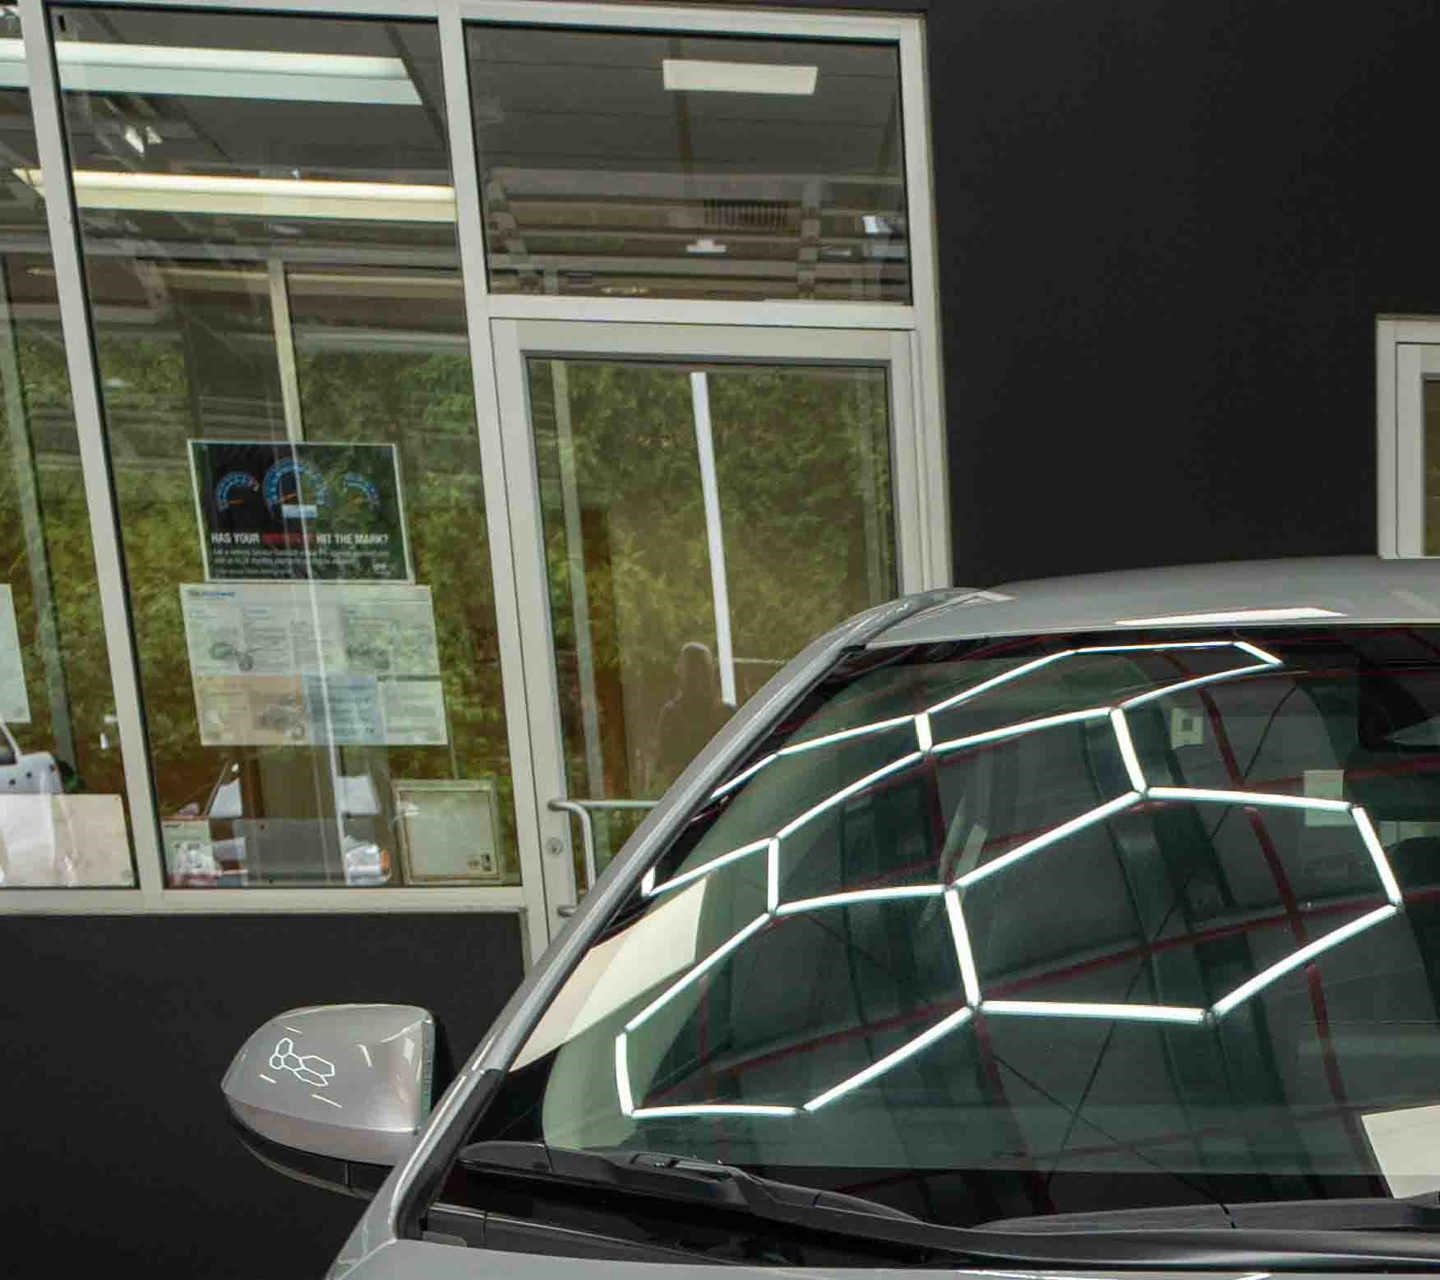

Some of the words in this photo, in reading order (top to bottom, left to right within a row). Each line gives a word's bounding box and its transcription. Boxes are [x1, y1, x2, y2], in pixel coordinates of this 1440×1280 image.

[211, 533, 232, 544] HAS
[233, 533, 260, 545] YOUR
[316, 533, 333, 545] HIT
[335, 533, 355, 545] THE
[356, 533, 389, 545] MARK?
